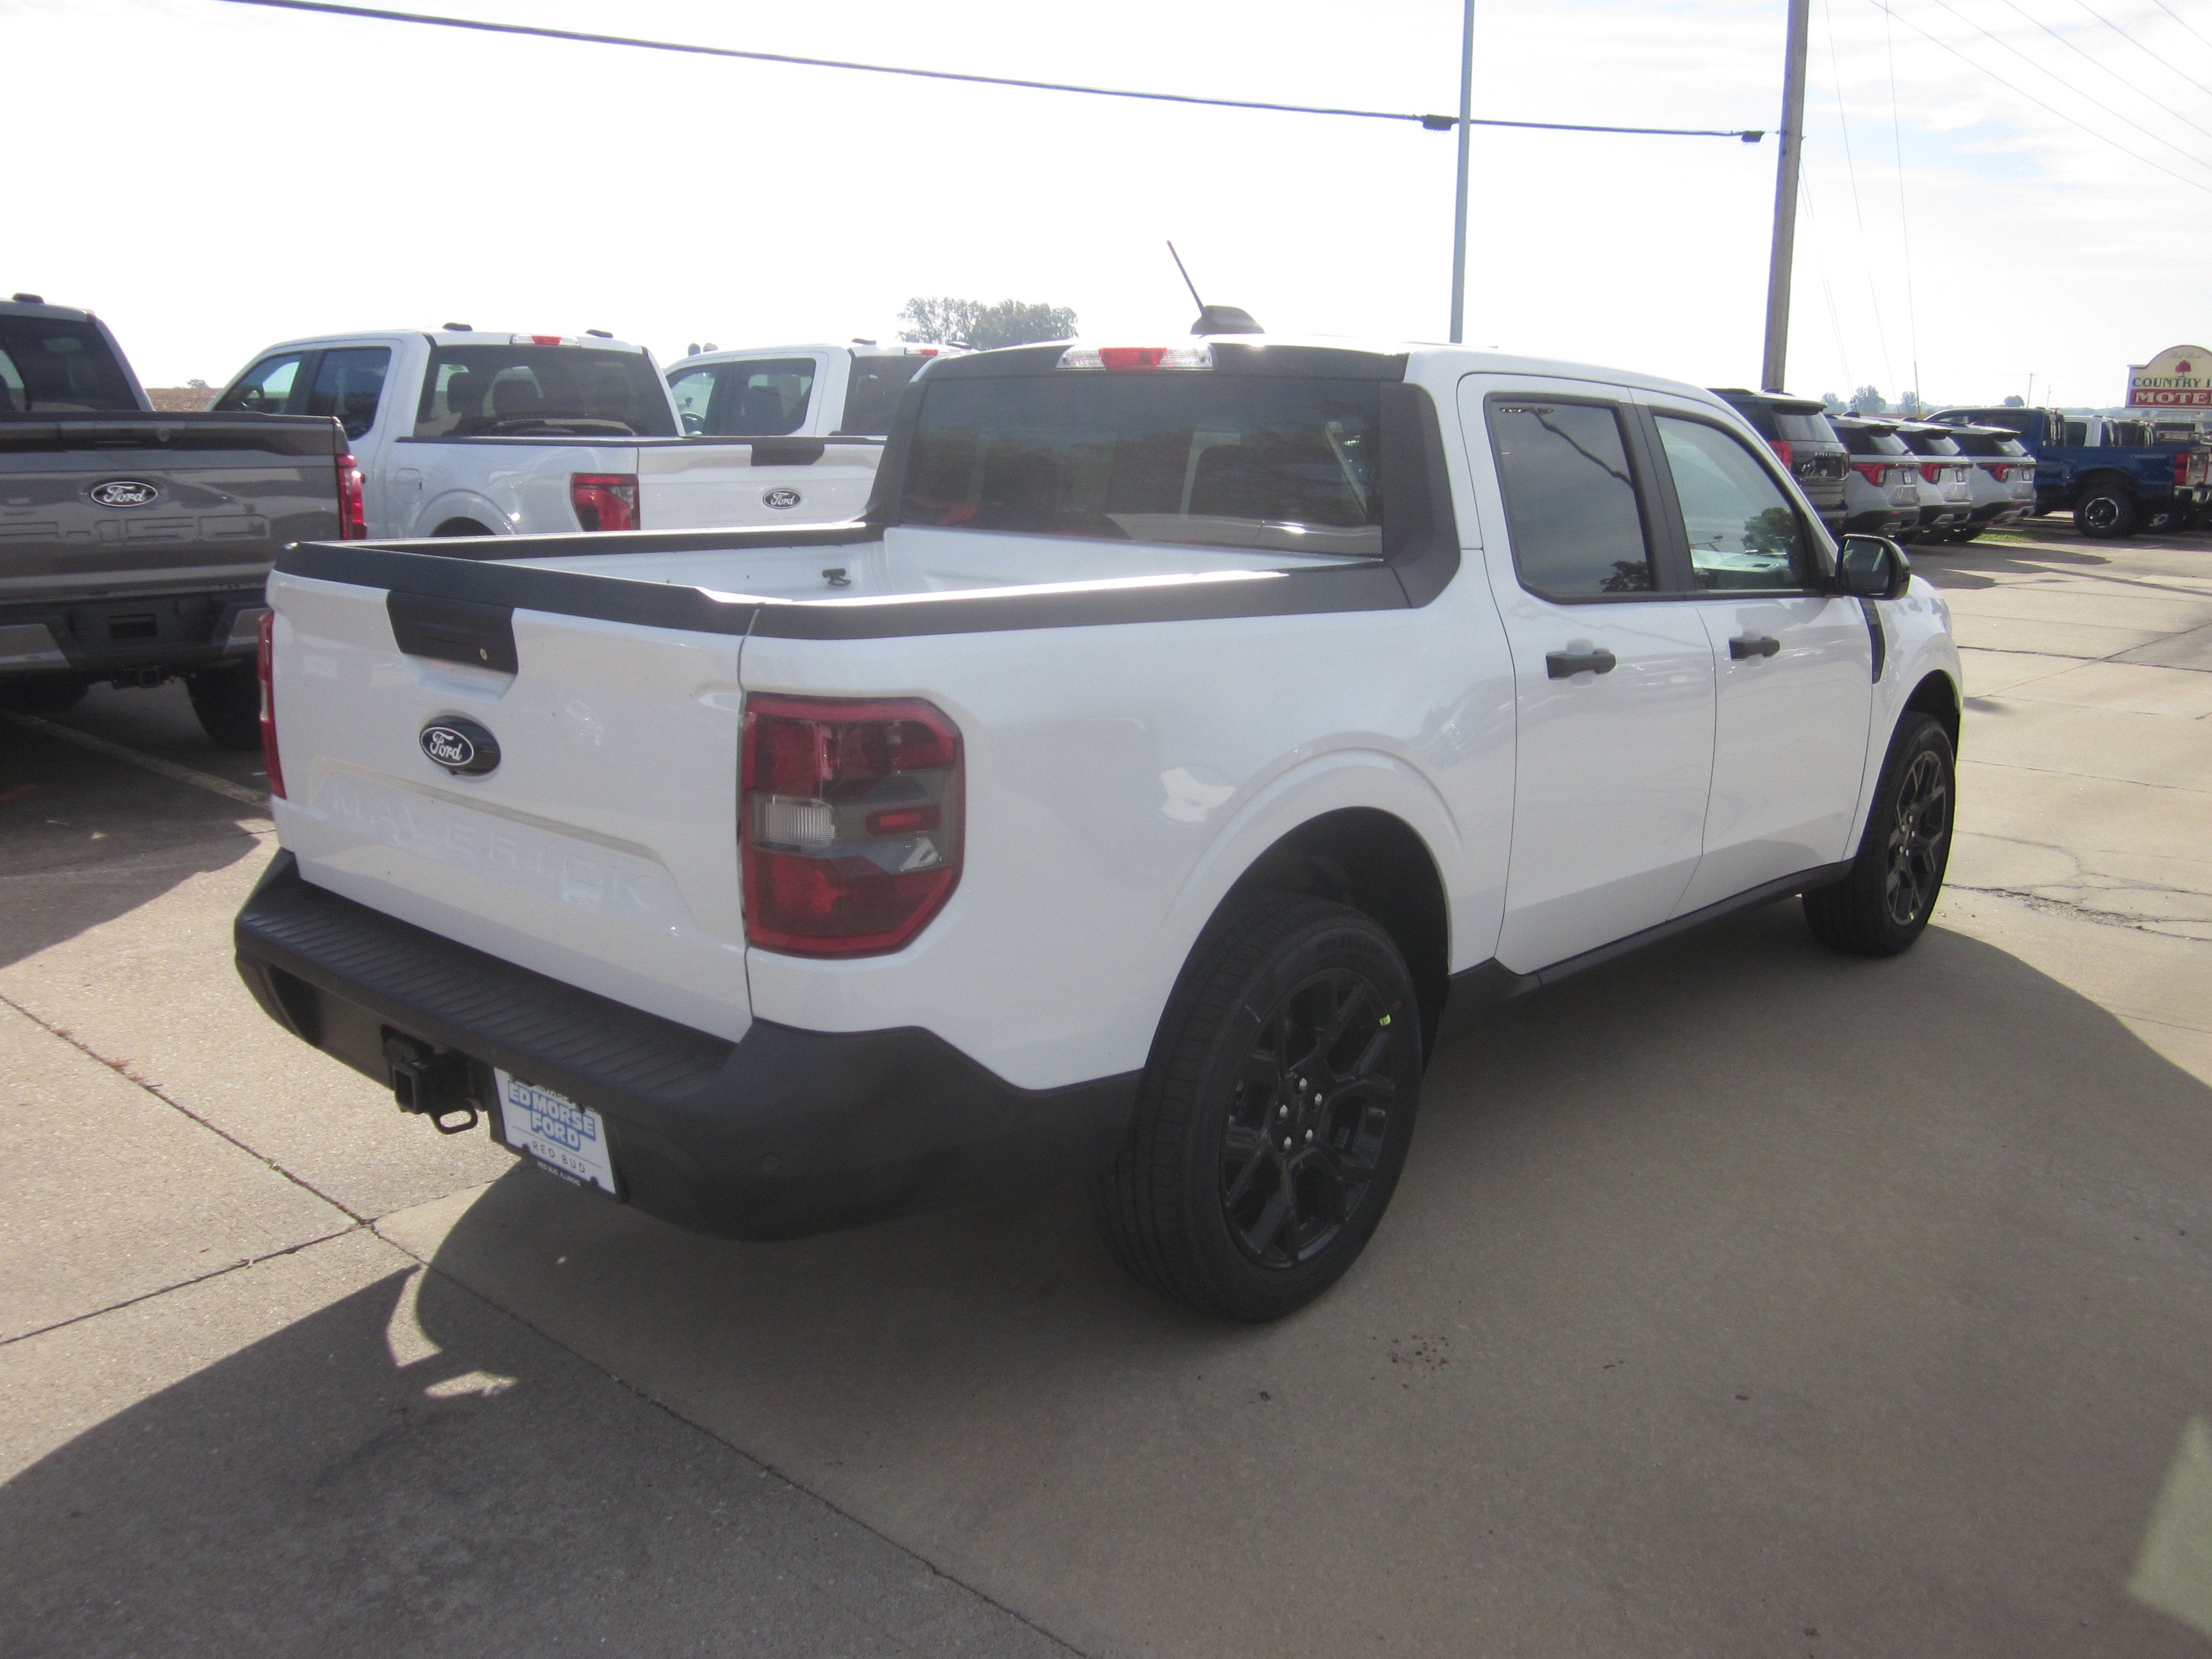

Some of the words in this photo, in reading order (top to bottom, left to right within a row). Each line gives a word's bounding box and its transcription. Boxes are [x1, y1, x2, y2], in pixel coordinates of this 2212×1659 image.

[2132, 378, 2201, 388] COUNTRY
[103, 485, 146, 502] Ford
[770, 492, 795, 505] Ford
[430, 731, 462, 760] Ford
[508, 1080, 531, 1108] ED
[531, 1091, 596, 1141] MORSE
[531, 1109, 580, 1151] FORD
[532, 1140, 556, 1159] RED
[561, 1154, 586, 1173] BUD
